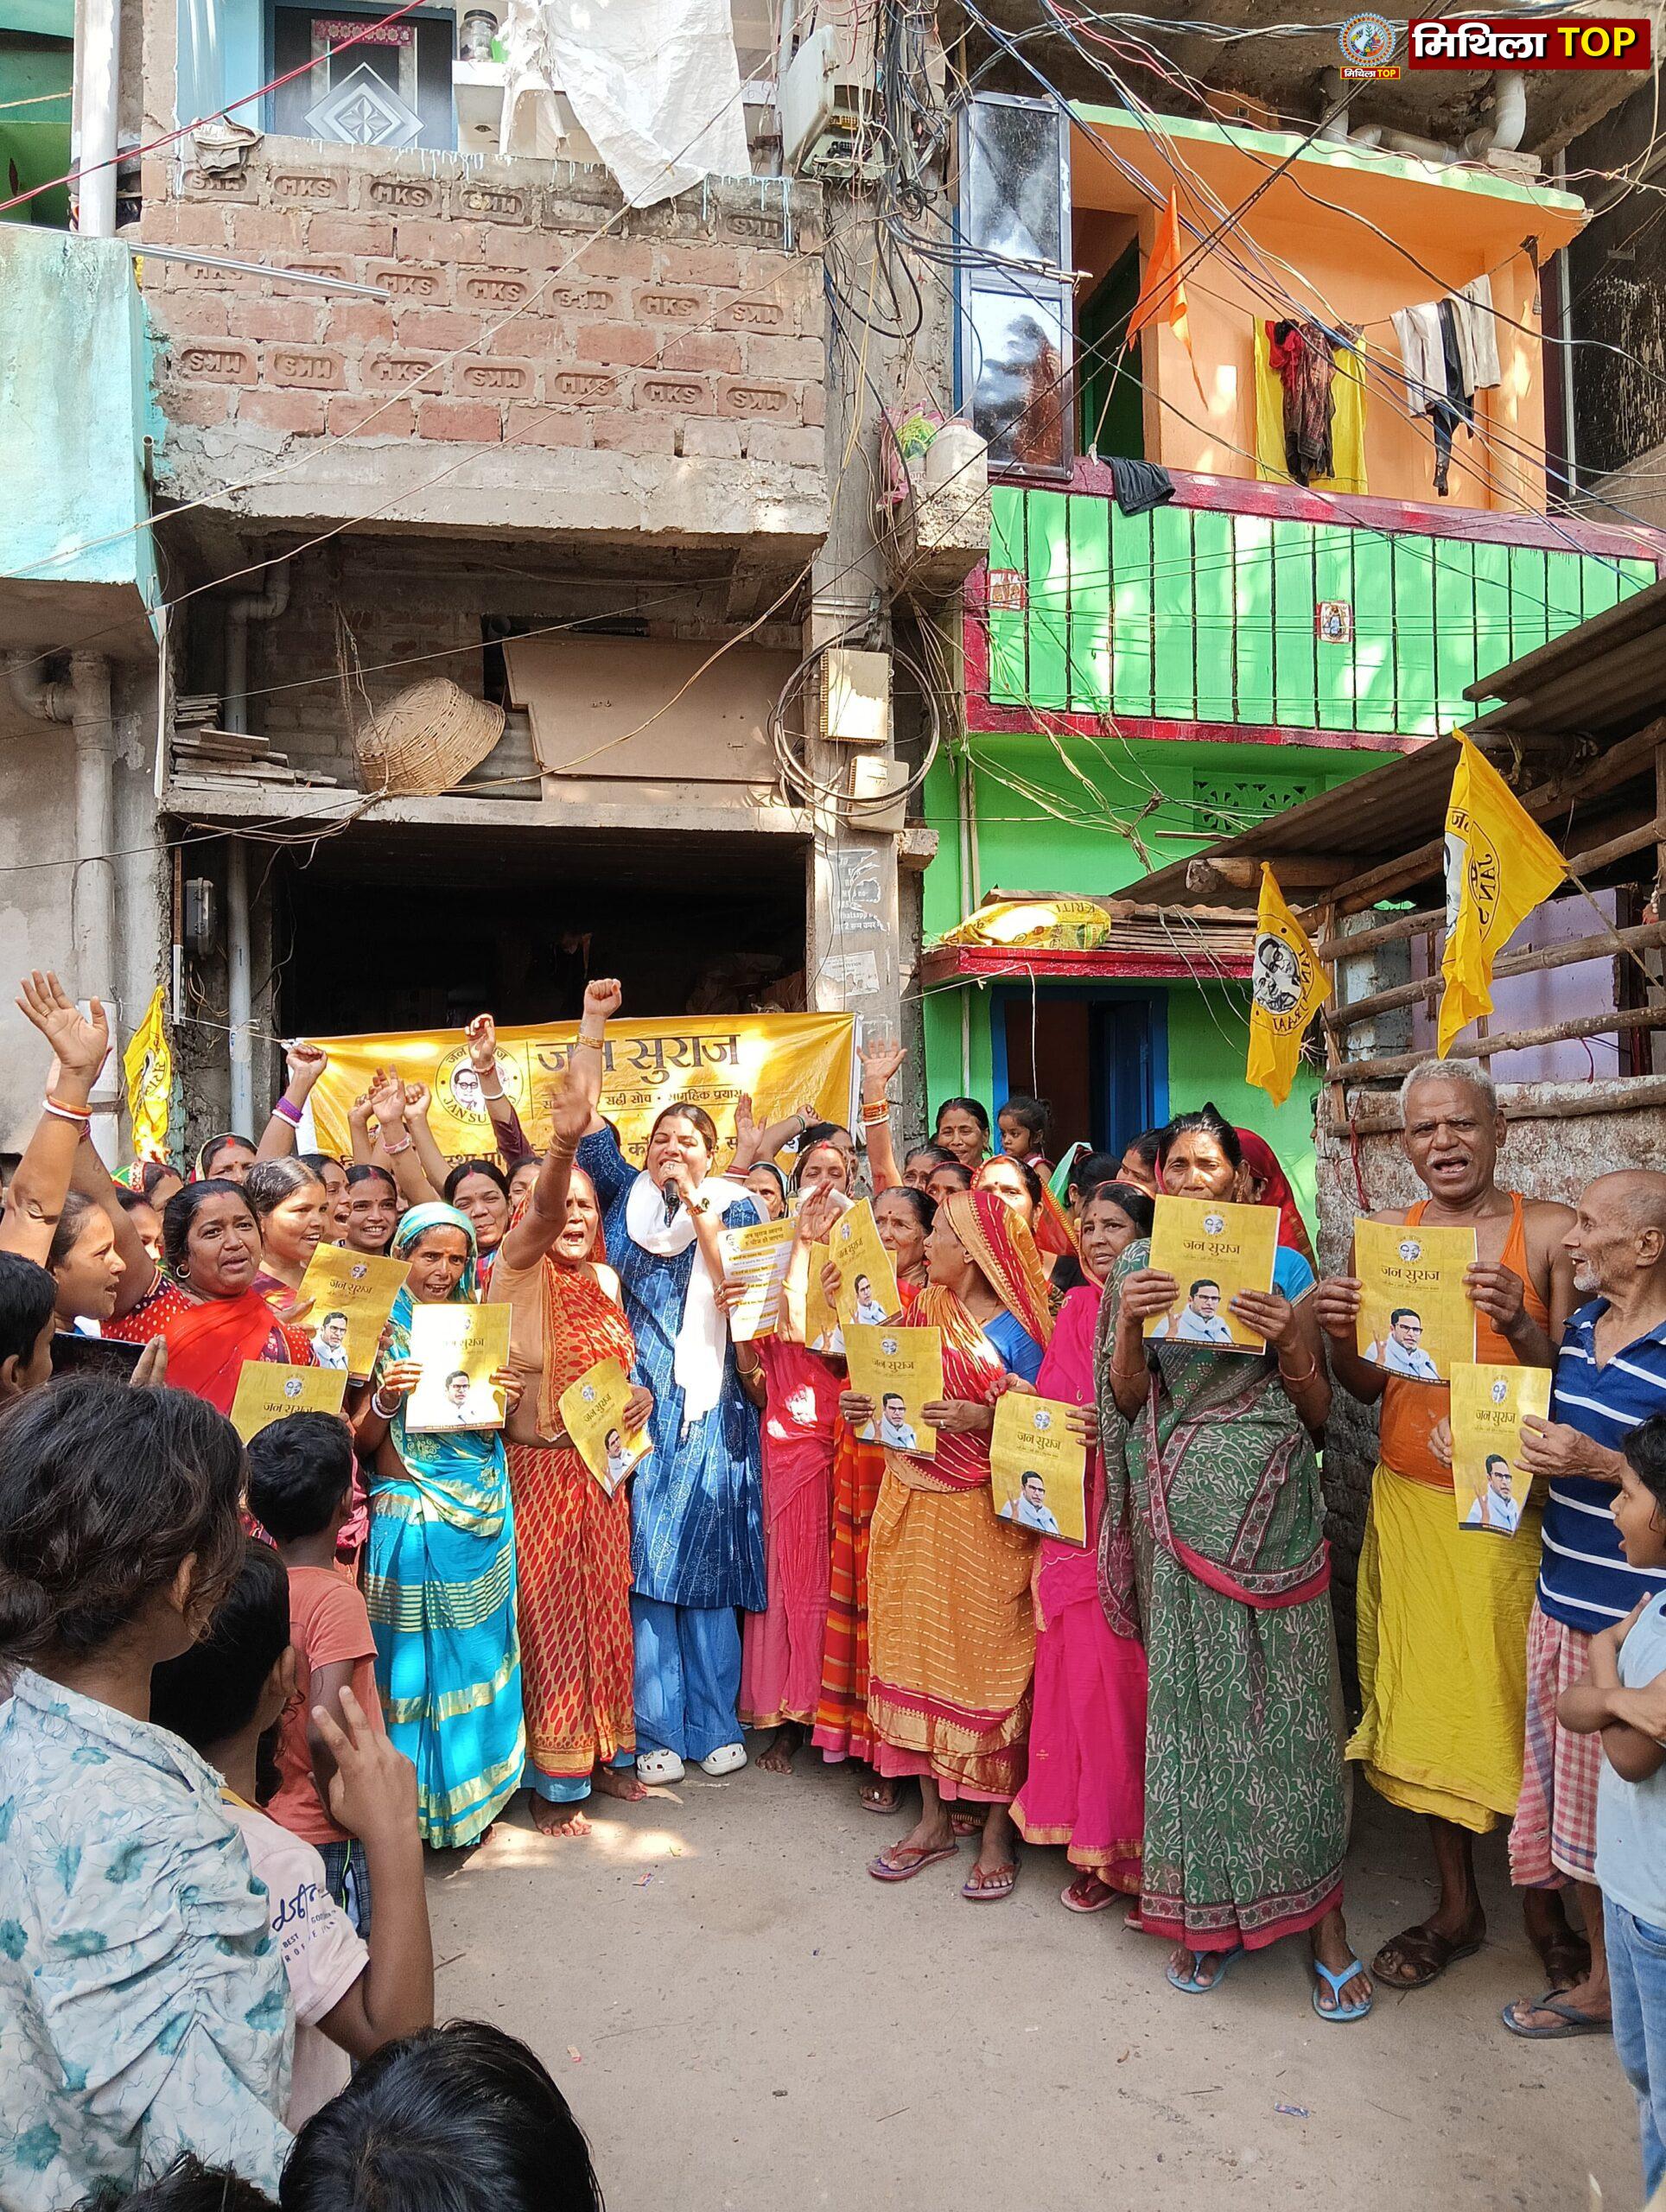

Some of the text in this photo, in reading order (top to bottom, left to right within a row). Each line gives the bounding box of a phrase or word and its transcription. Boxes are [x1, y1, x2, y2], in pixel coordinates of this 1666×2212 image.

[282, 175, 332, 198] MKS
[377, 184, 425, 207] MKS
[383, 275, 432, 296] MKS
[474, 282, 520, 302] MKS
[646, 296, 691, 316] MKS
[733, 304, 778, 325] MKS
[189, 353, 241, 374] MKS
[283, 357, 332, 378] MKS
[379, 362, 428, 381] MKS
[474, 369, 519, 389] MKS
[562, 373, 610, 396] MKS
[651, 384, 696, 404] MKS
[734, 389, 780, 411] MKS
[625, 1034, 741, 1085] सुराज
[631, 1091, 652, 1104] सोच
[443, 1098, 467, 1119] JAN
[1183, 1239, 1240, 1256] जन सुराज
[1381, 1265, 1440, 1284] जन सुराज
[329, 1279, 347, 1288] जन
[348, 1284, 373, 1295] सुराज
[887, 1361, 914, 1373] सुराज
[263, 1402, 283, 1413] जन
[1476, 1409, 1517, 1427] जन सुराज
[1017, 1431, 1061, 1450] जन सुराज
[282, 1932, 300, 1949] BEST
